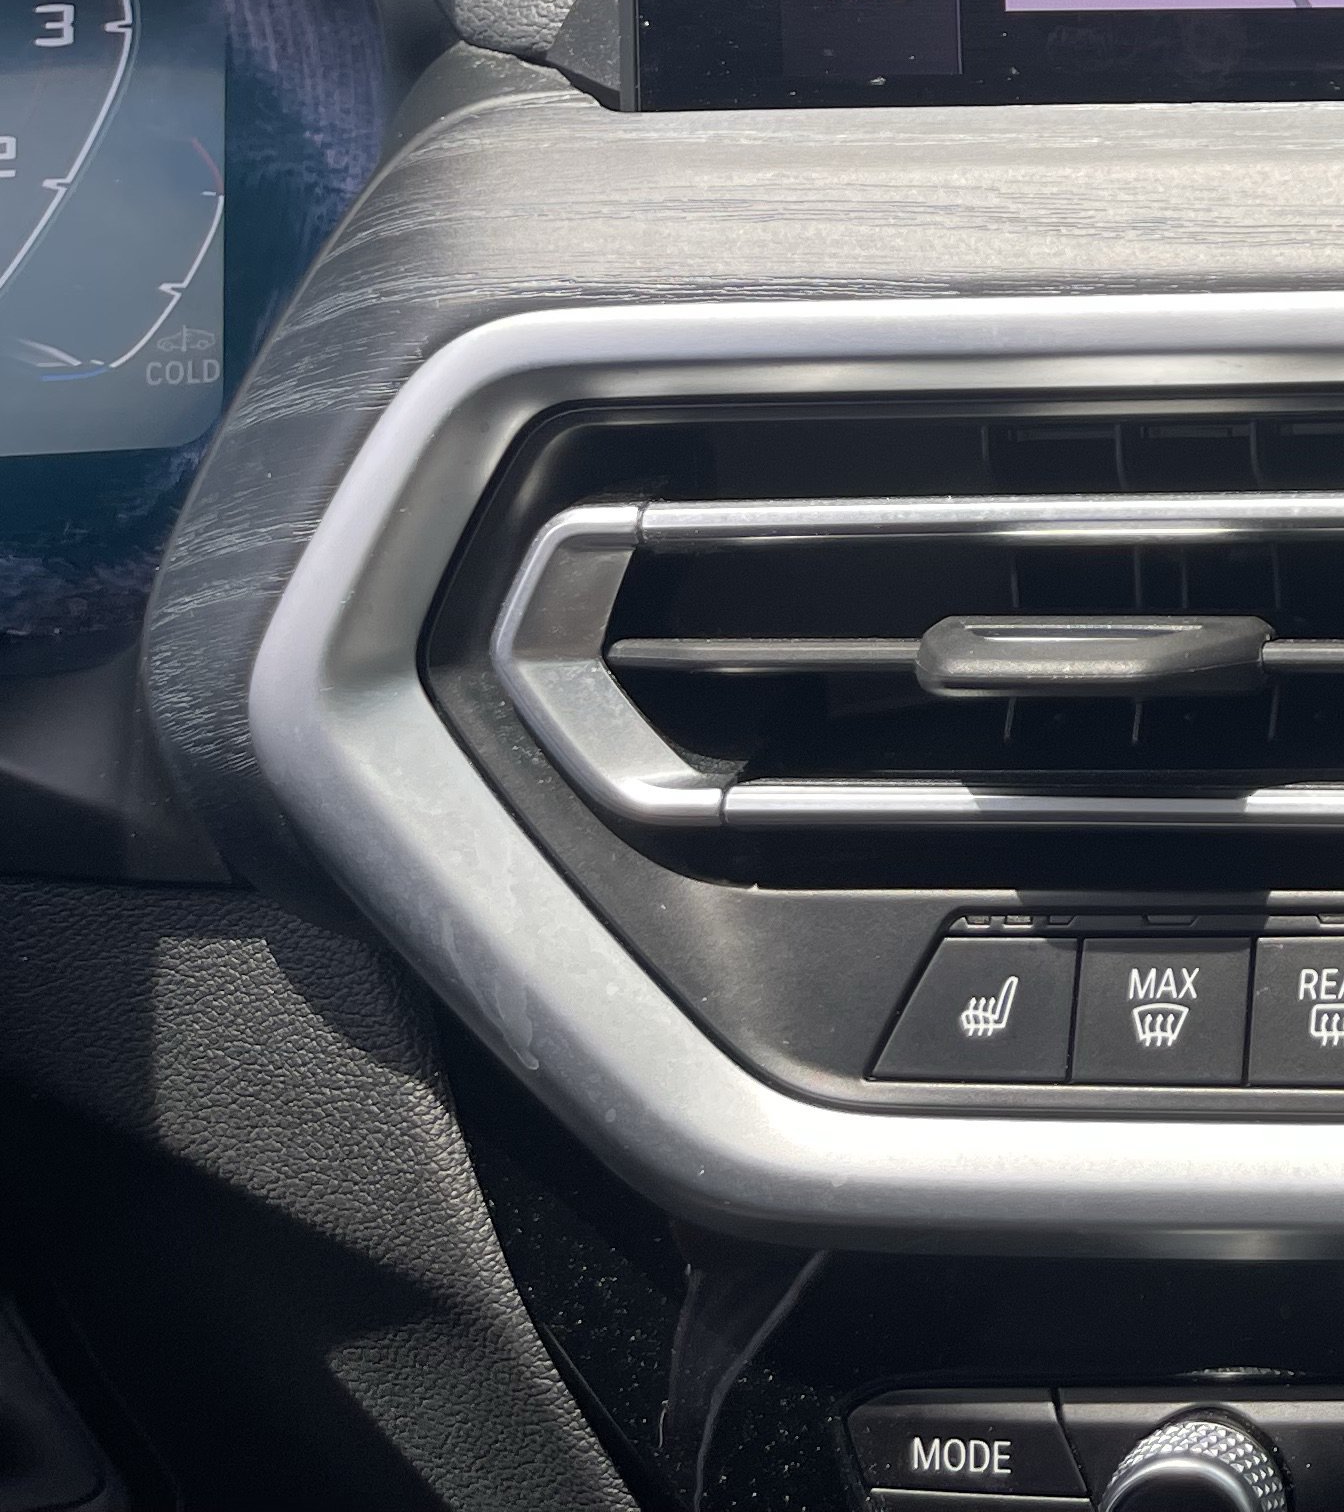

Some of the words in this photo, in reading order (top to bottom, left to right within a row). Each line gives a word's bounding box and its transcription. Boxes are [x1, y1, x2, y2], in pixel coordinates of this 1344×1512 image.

[34, 4, 75, 47] 3
[144, 358, 222, 387] COLD
[1128, 967, 1200, 1000] MAX
[912, 1436, 1012, 1474] MODE
